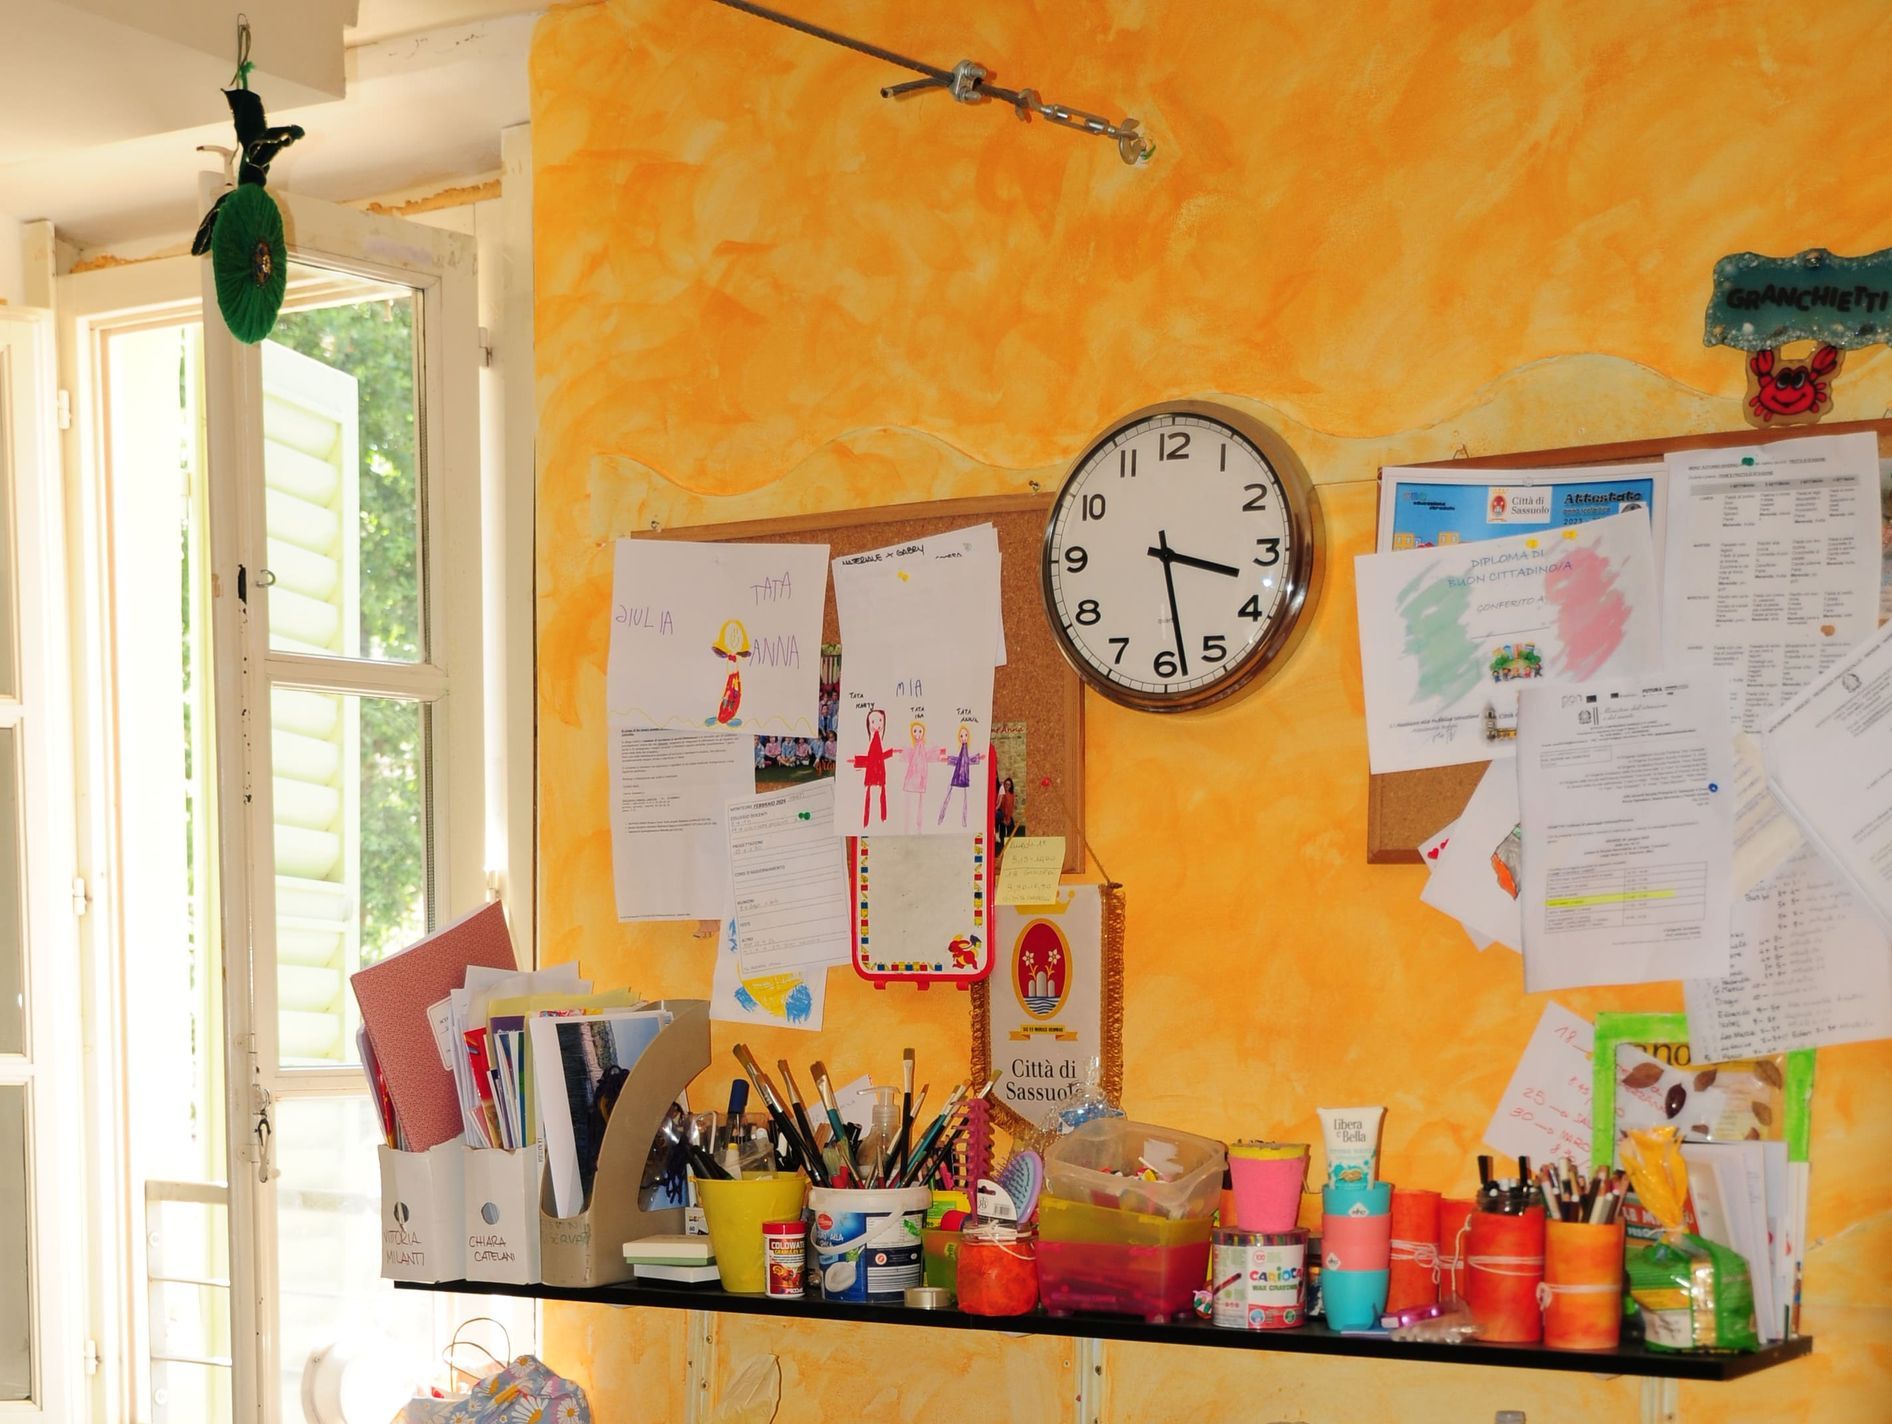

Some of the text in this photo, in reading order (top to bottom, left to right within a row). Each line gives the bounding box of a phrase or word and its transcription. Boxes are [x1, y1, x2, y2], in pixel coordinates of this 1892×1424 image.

[1726, 284, 1888, 312] GRANCHIETTI
[1159, 432, 1191, 461] 12
[1120, 449, 1137, 478] 11
[1082, 493, 1106, 521] 10
[1242, 484, 1267, 512] 2
[1511, 506, 1550, 516] Sassuolo
[1064, 546, 1088, 573] 9
[1252, 538, 1280, 566] 3
[1471, 549, 1545, 568] DIPLOMA DI
[750, 571, 791, 605] TATA
[1448, 575, 1486, 588] BUON
[1075, 599, 1101, 626] 8
[1238, 594, 1262, 622] 4
[1476, 597, 1535, 613] CONFERITO
[749, 634, 800, 669] ANNA
[1108, 637, 1130, 664] 7
[1201, 635, 1227, 662] 5
[1153, 651, 1178, 678] 6
[896, 679, 923, 697] MIA
[1012, 1058, 1077, 1078] Città di
[1522, 1087, 1545, 1106] 25
[1333, 1118, 1362, 1130] Libera
[1342, 1131, 1367, 1143] Bella
[468, 1235, 506, 1248] CHIARA
